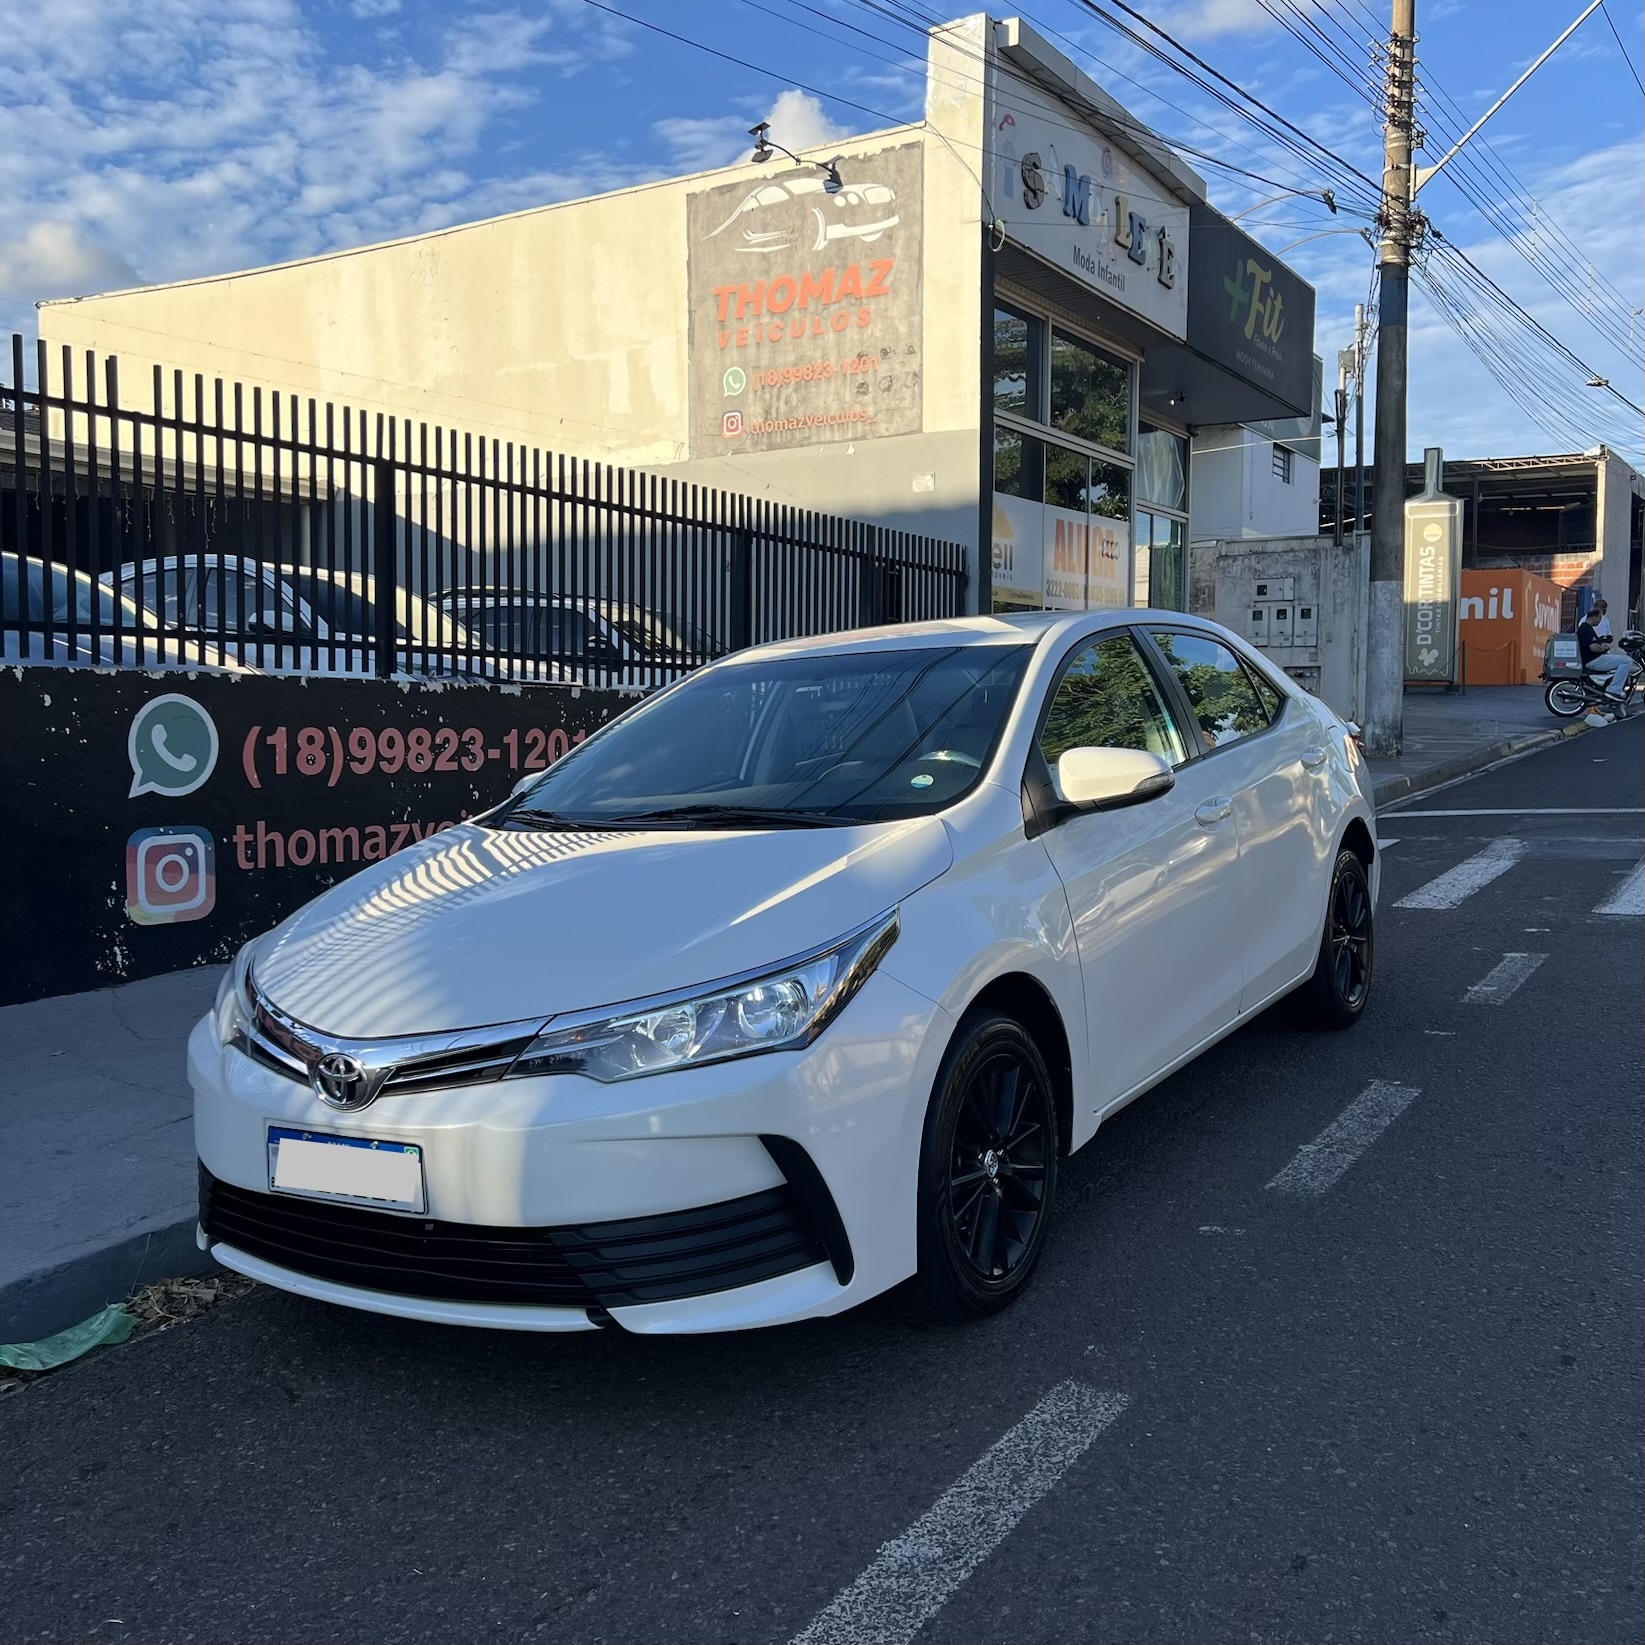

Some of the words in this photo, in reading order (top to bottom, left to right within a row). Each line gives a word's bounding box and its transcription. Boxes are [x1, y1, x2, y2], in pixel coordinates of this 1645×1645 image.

[714, 258, 893, 322] THOMAZ
[1073, 245, 1095, 275] Moda
[1098, 259, 1126, 292] Infantil
[1053, 519, 1116, 579] ALUGA
